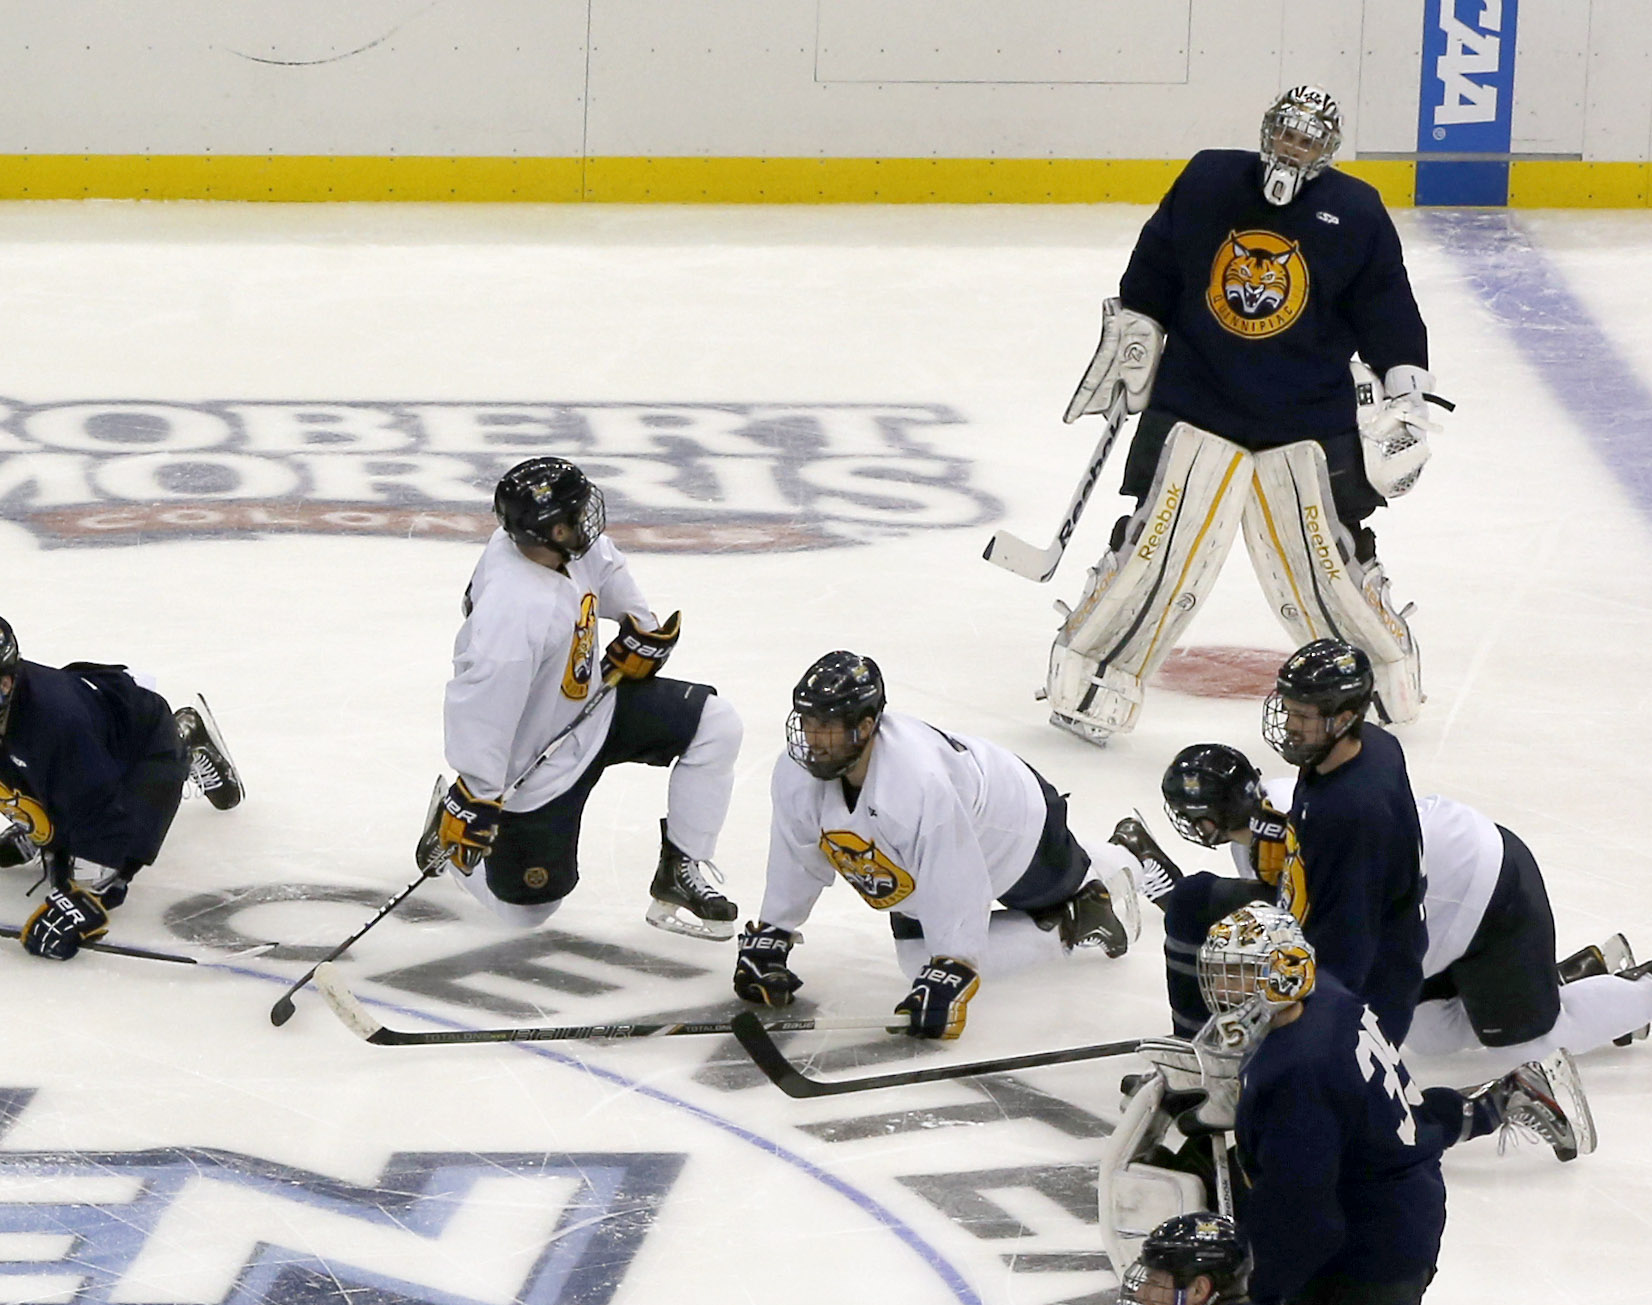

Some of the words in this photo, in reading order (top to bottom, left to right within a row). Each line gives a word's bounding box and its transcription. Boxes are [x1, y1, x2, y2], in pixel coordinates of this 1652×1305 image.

[1432, 0, 1504, 126] CAA
[1137, 481, 1183, 562] Reebok
[1303, 505, 1341, 581] Reebok
[624, 635, 668, 659] BAU
